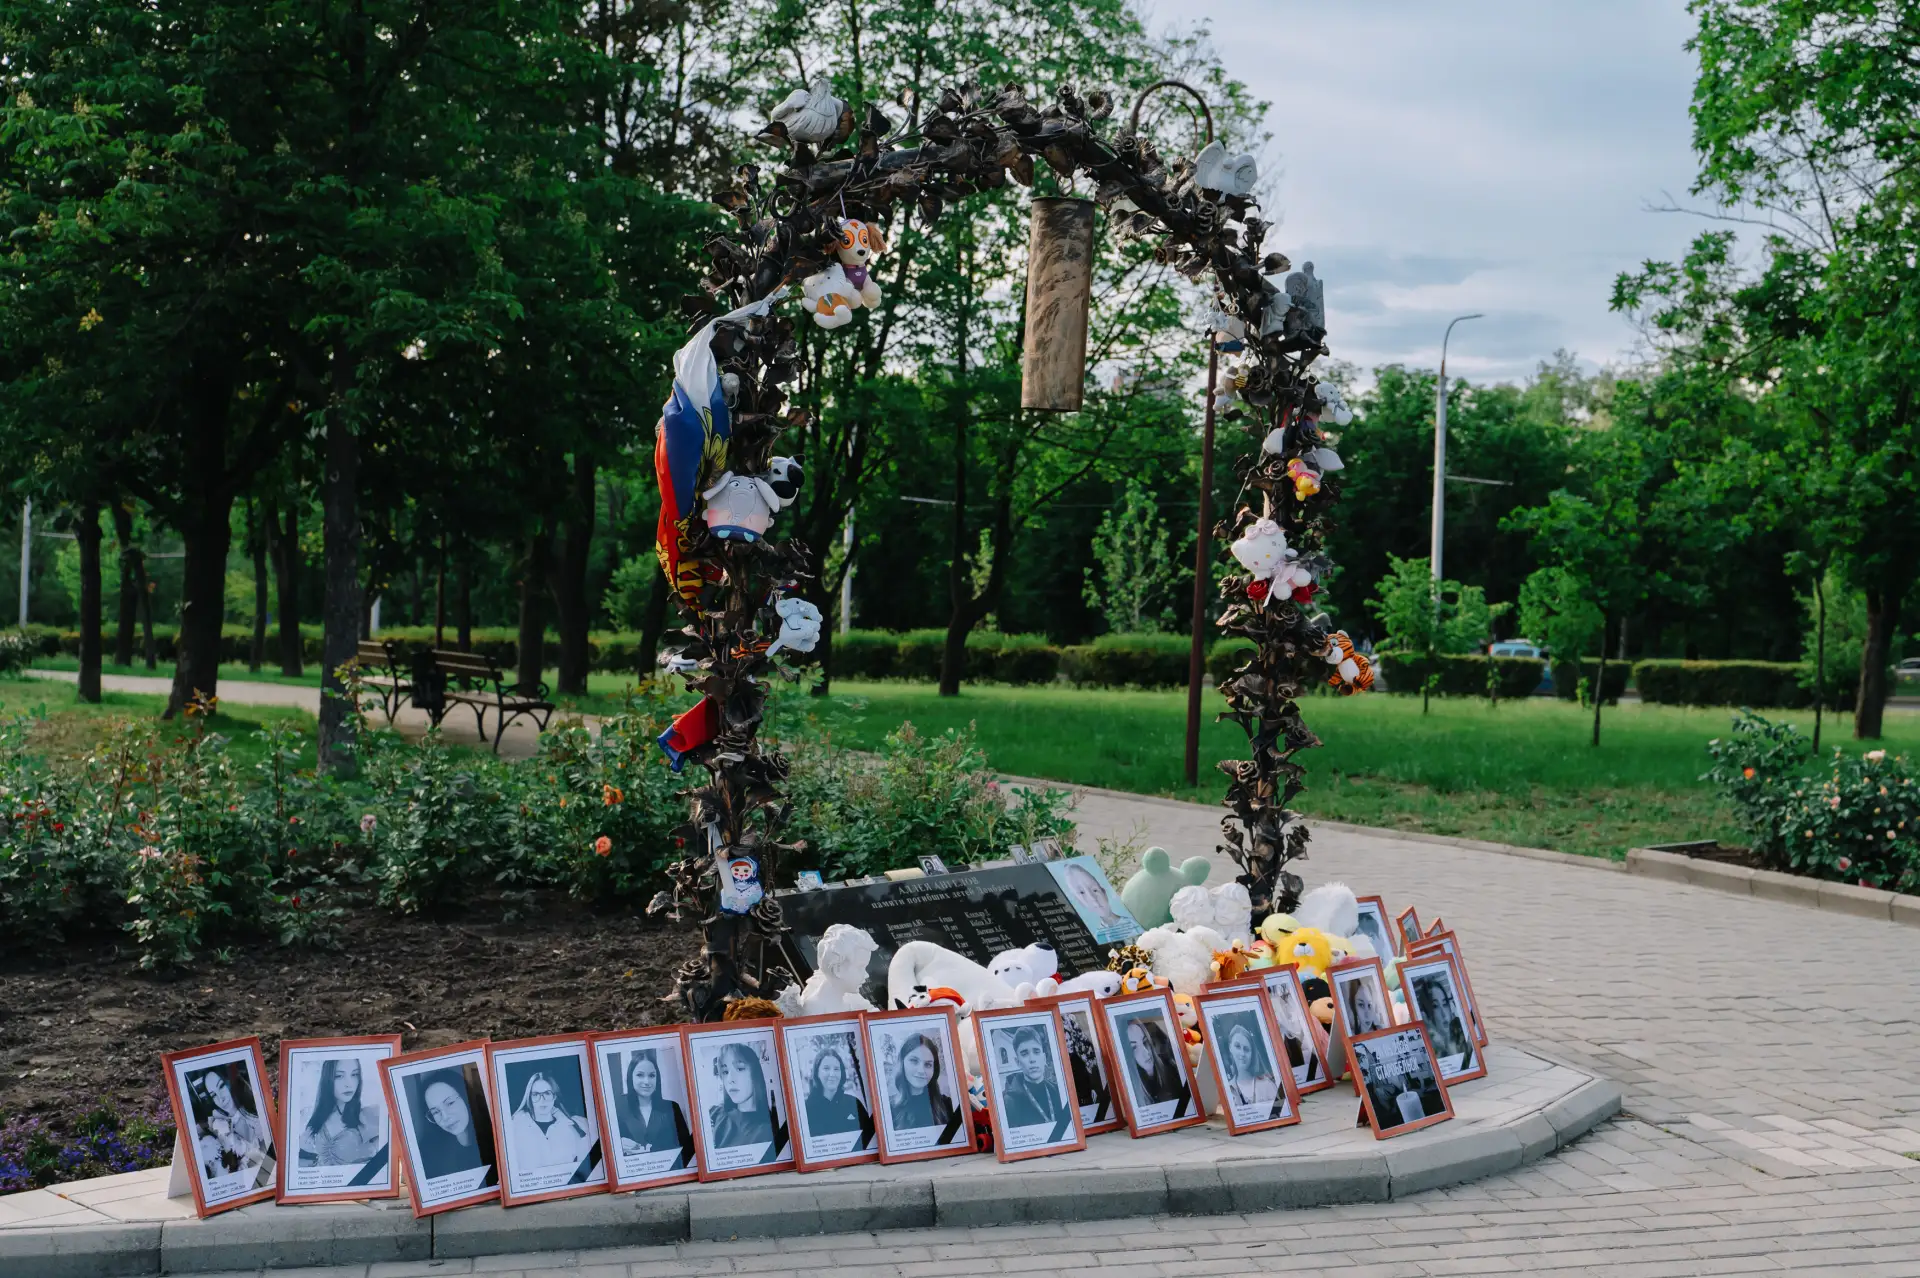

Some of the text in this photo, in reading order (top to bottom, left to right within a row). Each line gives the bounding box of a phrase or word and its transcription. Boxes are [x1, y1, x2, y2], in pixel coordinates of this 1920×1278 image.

[871, 884, 1015, 909] памяти погибших детей Донбасса
[898, 876, 981, 895] АЛЛЕЯ АНГЕЛОВ
[1375, 1057, 1420, 1081] СТАРОБЕЛЬСК
